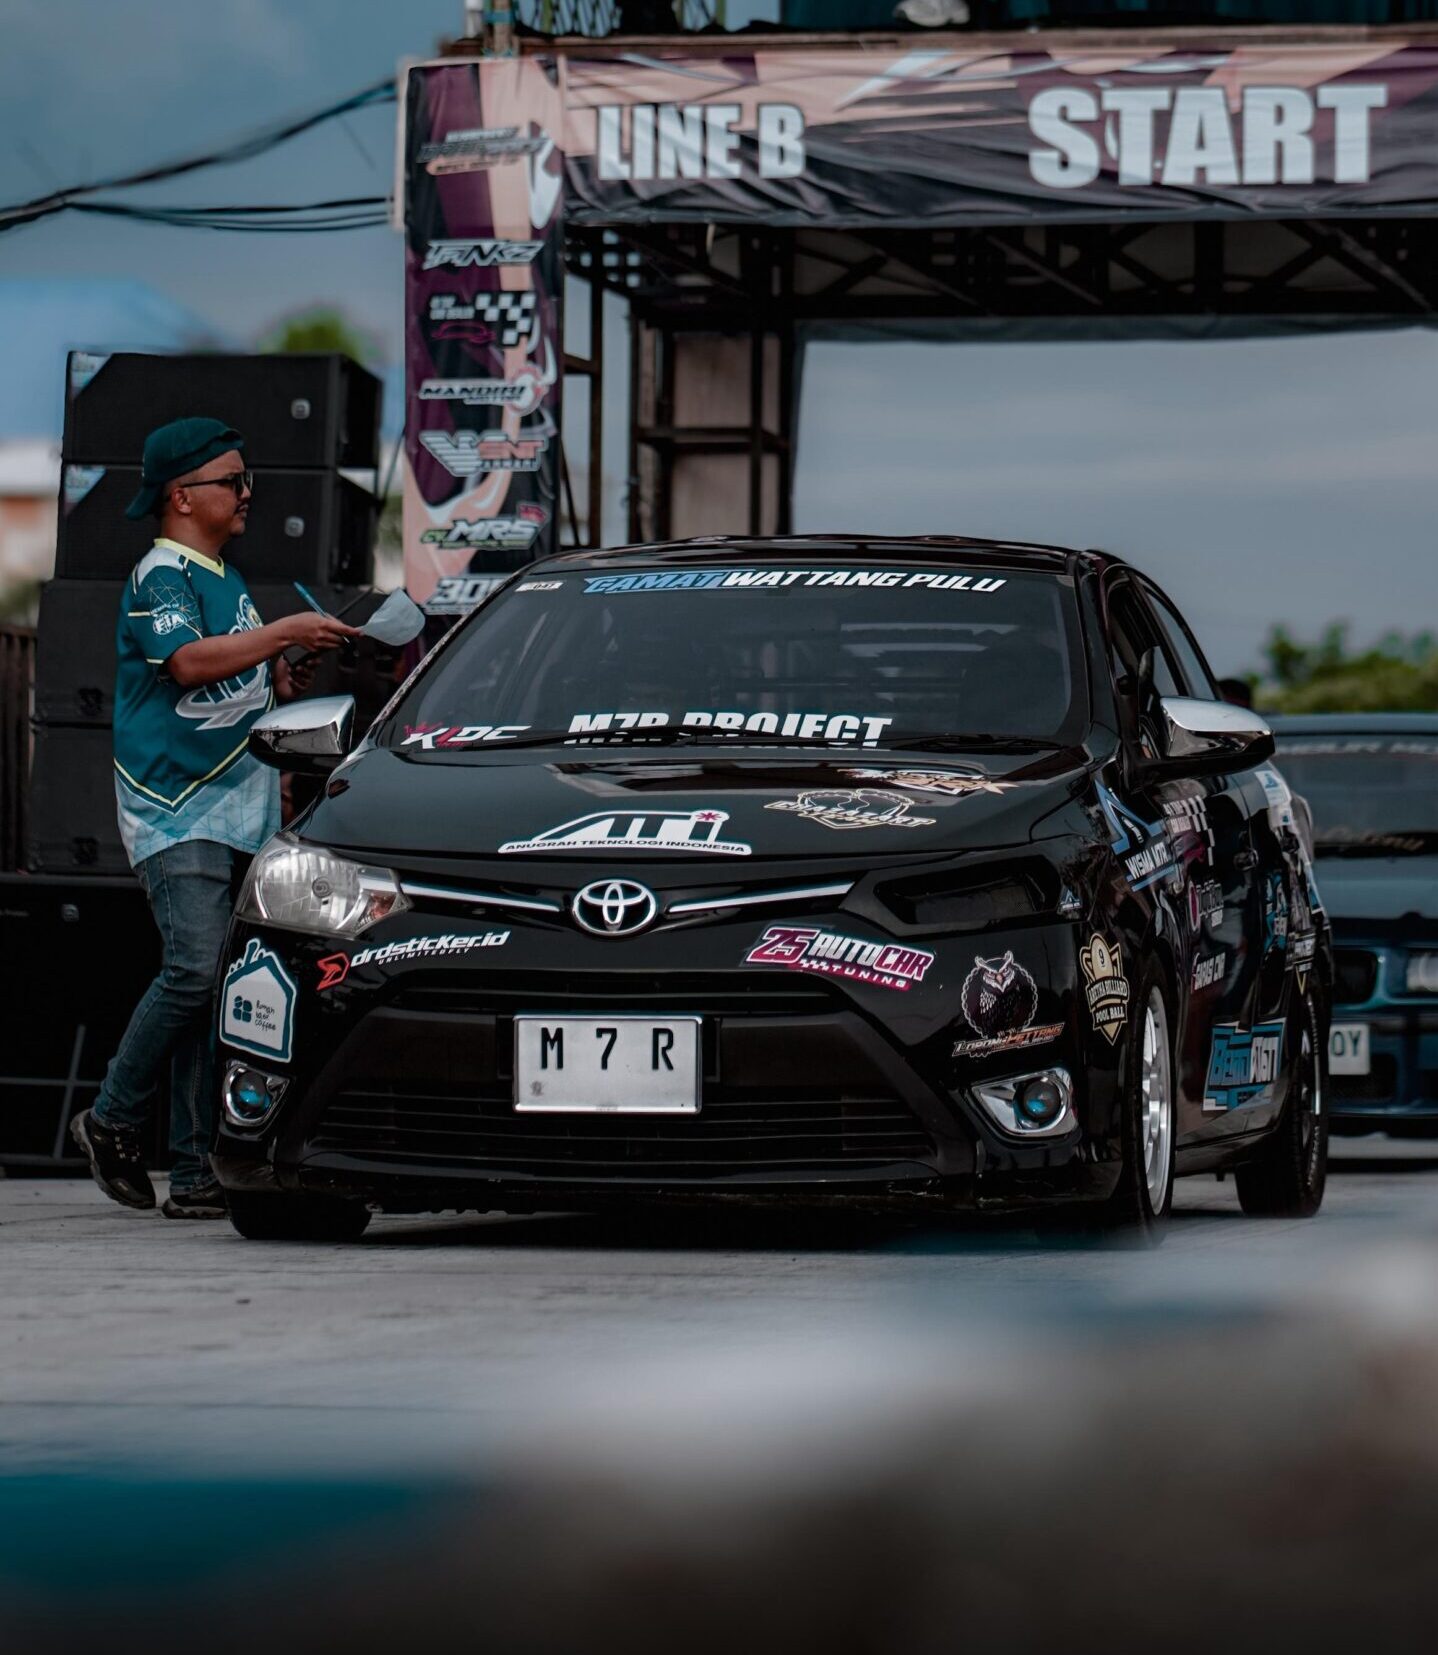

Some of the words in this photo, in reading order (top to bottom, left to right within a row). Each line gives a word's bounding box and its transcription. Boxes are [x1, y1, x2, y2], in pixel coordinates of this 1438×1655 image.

[597, 103, 742, 180] LINE
[757, 103, 806, 180] B
[1028, 83, 1388, 188] START
[721, 570, 906, 588] WATTANG
[902, 573, 1007, 593] PULU
[154, 613, 185, 634] FIA
[506, 840, 577, 851] ANUGRAH
[579, 839, 664, 847] TEKNOLOGI
[664, 840, 746, 852] INDONESIA
[746, 927, 820, 964] 25
[1098, 948, 1105, 968] 9
[831, 964, 907, 988] TUNING
[1109, 1005, 1125, 1020] BALL
[540, 1027, 564, 1070] M
[595, 1027, 618, 1070] 7
[652, 1027, 675, 1070] R
